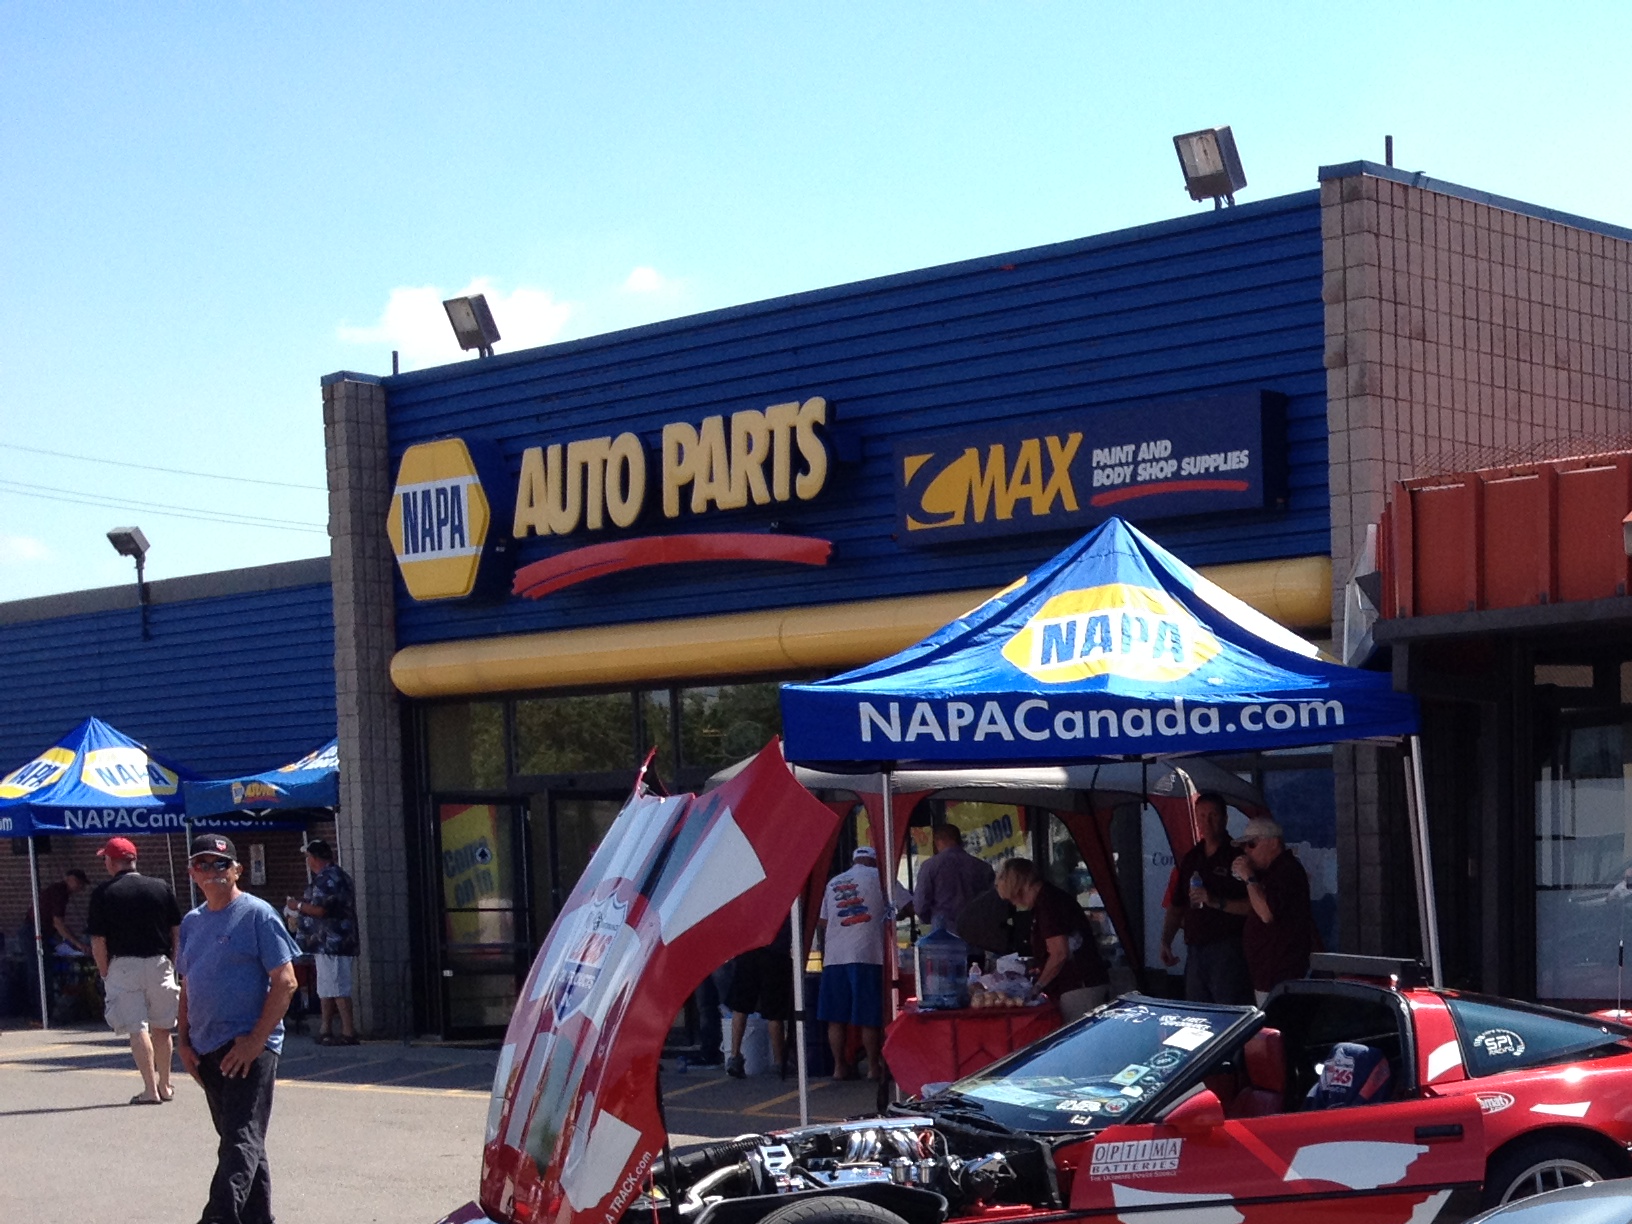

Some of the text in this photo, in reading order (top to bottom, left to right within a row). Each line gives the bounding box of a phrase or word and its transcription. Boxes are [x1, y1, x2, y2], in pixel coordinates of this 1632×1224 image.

[513, 396, 826, 538] AUTO PARTS
[1092, 440, 1172, 467] PAINT AND
[1093, 450, 1249, 487] BODY SHOP SUPPLIES
[402, 485, 466, 555] NAPA
[1040, 612, 1186, 666] NAPA
[859, 697, 1345, 742] NAPACanada.com
[1092, 1160, 1176, 1173] BATTERIES
[1094, 1140, 1178, 1161] OPTIMA
[609, 1151, 652, 1213] TRACK.com
[605, 1214, 615, 1224] A
